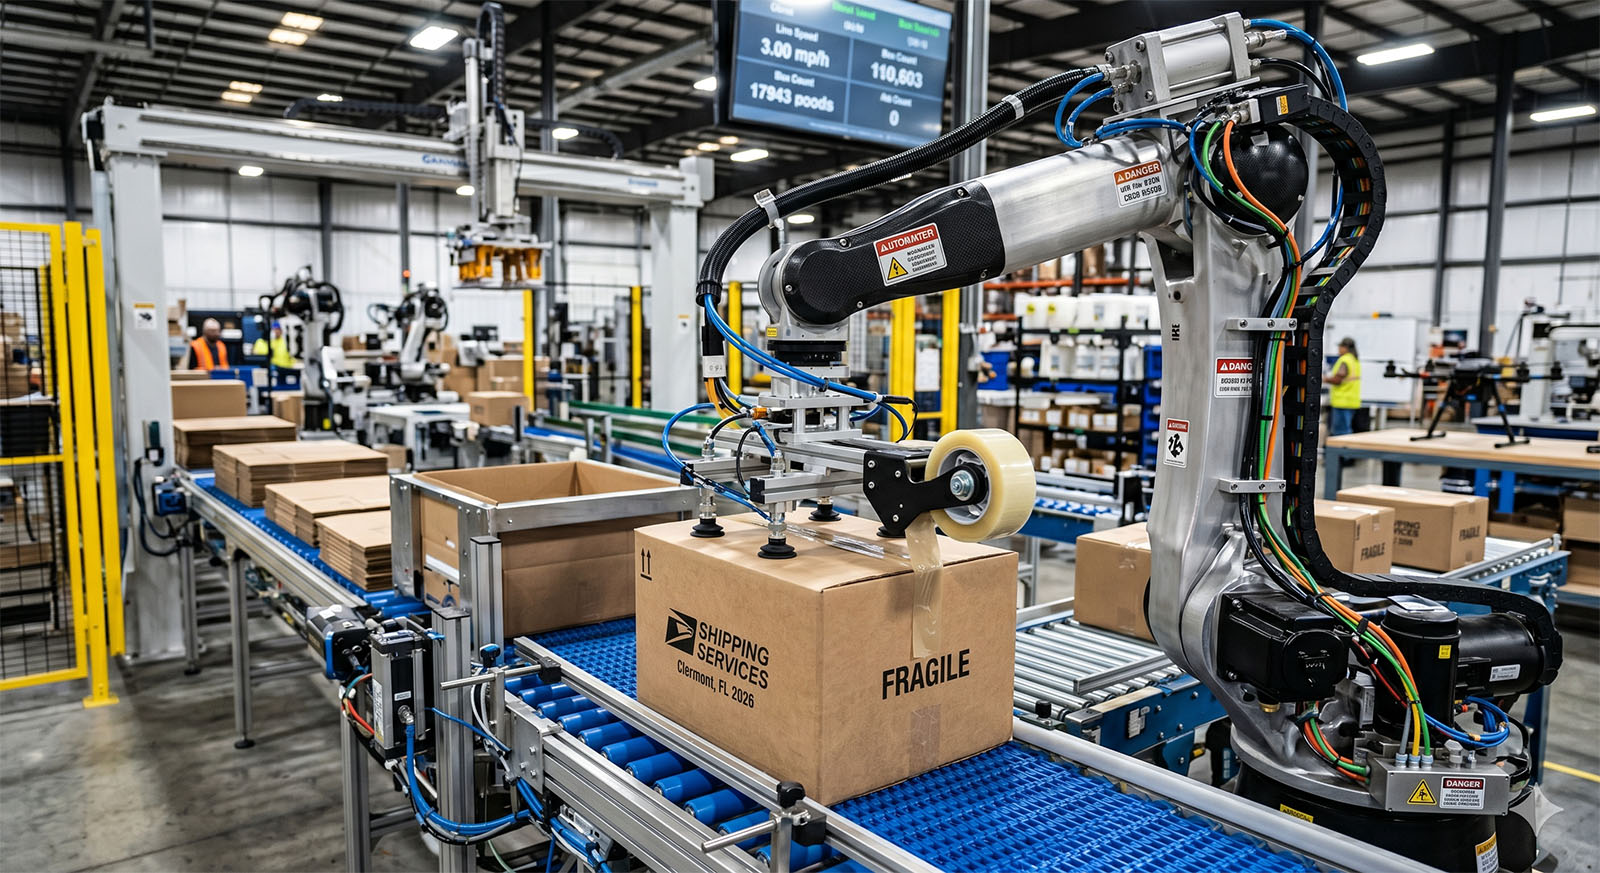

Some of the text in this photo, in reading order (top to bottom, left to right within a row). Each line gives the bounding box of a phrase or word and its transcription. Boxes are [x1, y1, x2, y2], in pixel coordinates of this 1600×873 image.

[760, 37, 793, 60] 3.00
[870, 62, 923, 88] 110,603
[750, 82, 792, 104] 17943
[888, 110, 900, 126] 0
[1125, 163, 1160, 180] DANGER
[1229, 362, 1253, 370] DANG
[1360, 541, 1386, 561] FRAGILE
[698, 622, 769, 666] SHIPPING
[697, 642, 770, 690] SERVICES
[882, 648, 971, 700] FRAGILE
[677, 659, 755, 708] Clermont, FL 2026
[1446, 780, 1481, 788] DANGER
